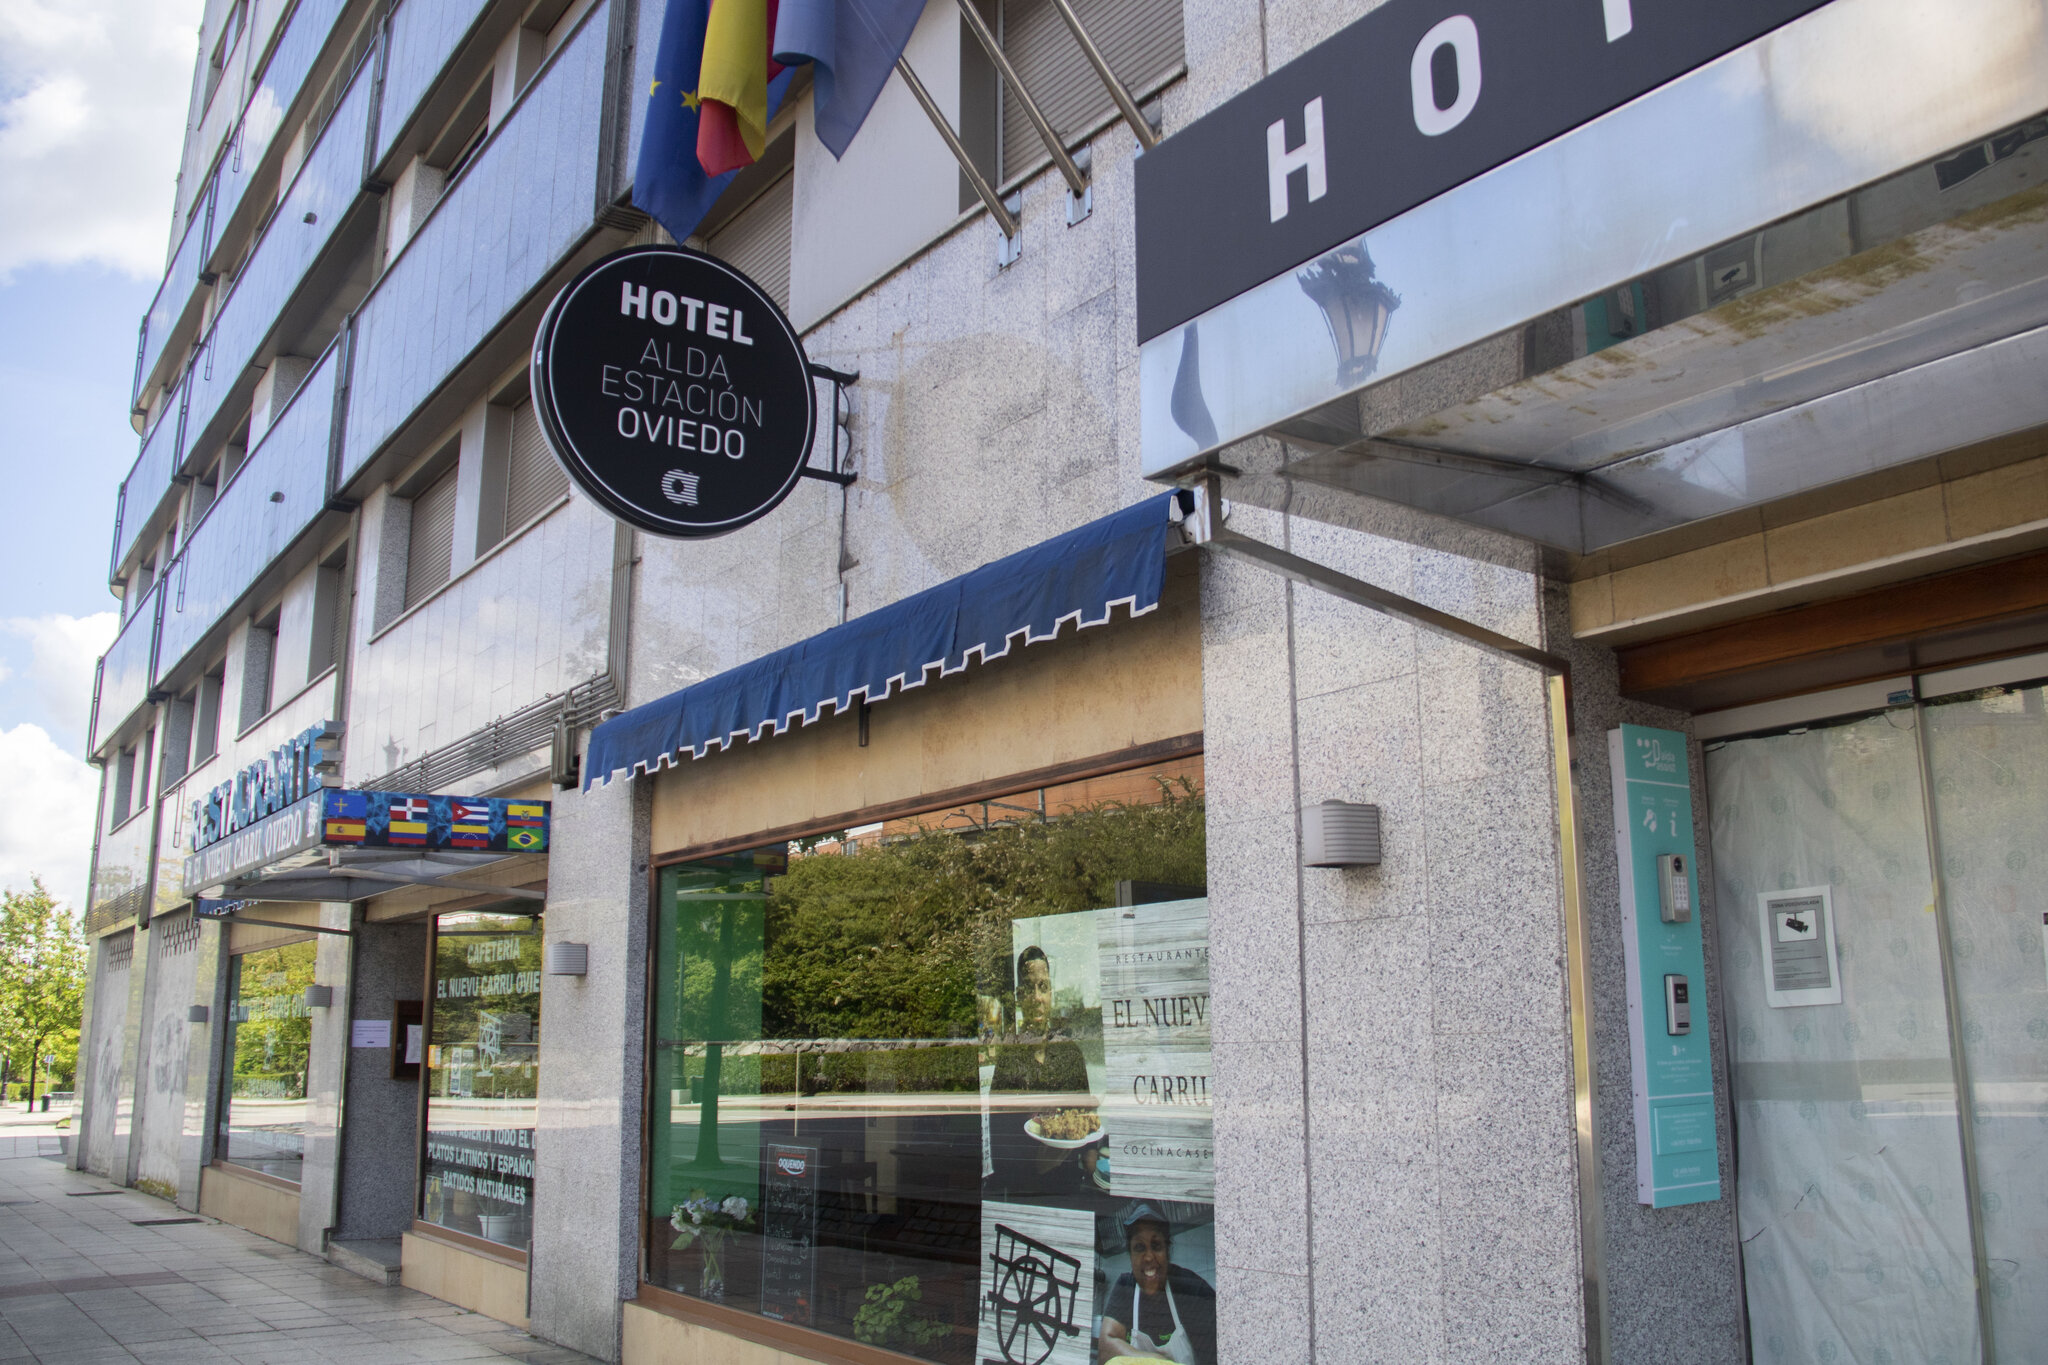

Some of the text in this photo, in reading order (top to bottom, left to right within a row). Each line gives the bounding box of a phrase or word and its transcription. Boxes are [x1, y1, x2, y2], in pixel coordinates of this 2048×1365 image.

[620, 281, 754, 346] HOTEL
[640, 338, 730, 384] ALDA
[601, 364, 763, 428] ESTACIÓN
[618, 407, 745, 460] OVIEDO
[191, 719, 326, 852] RESTAURANTE
[265, 809, 302, 857] OVIEDO
[467, 933, 521, 965] CAFETERÍA
[1116, 948, 1210, 965] RESTAURANTE
[437, 979, 448, 998] EL
[449, 976, 480, 997] NUEVU
[481, 973, 514, 996] CARRU
[1112, 999, 1138, 1028] EL
[1133, 1076, 1209, 1106] CARRU
[494, 1129, 517, 1146] TODO
[518, 1130, 530, 1149] EL
[428, 1142, 454, 1163] PLATOS
[455, 1147, 488, 1170] LATINOS
[489, 1152, 497, 1171] Y
[443, 1170, 526, 1206] BATIDOS NATURALES
